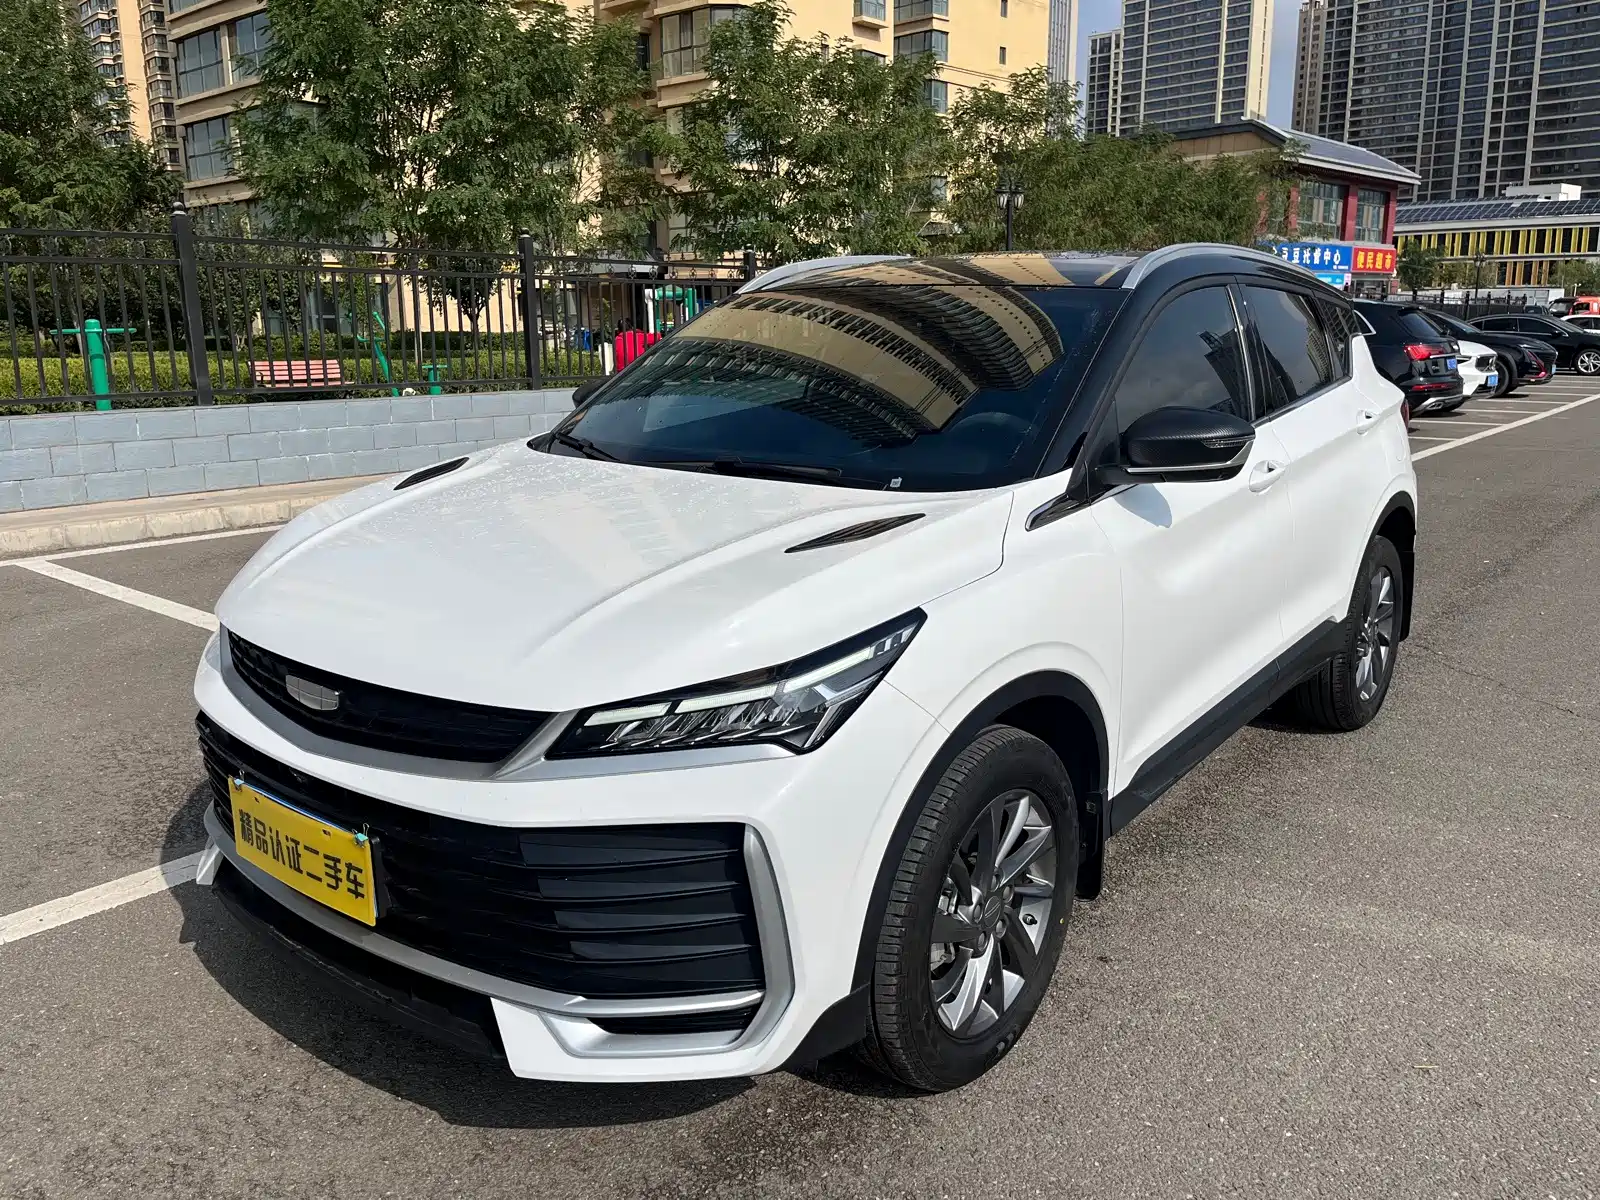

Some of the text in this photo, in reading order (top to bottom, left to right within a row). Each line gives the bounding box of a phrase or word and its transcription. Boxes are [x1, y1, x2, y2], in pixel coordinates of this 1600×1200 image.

[1357, 250, 1392, 269] 便民超市
[238, 808, 366, 900] 精品认证二手车
